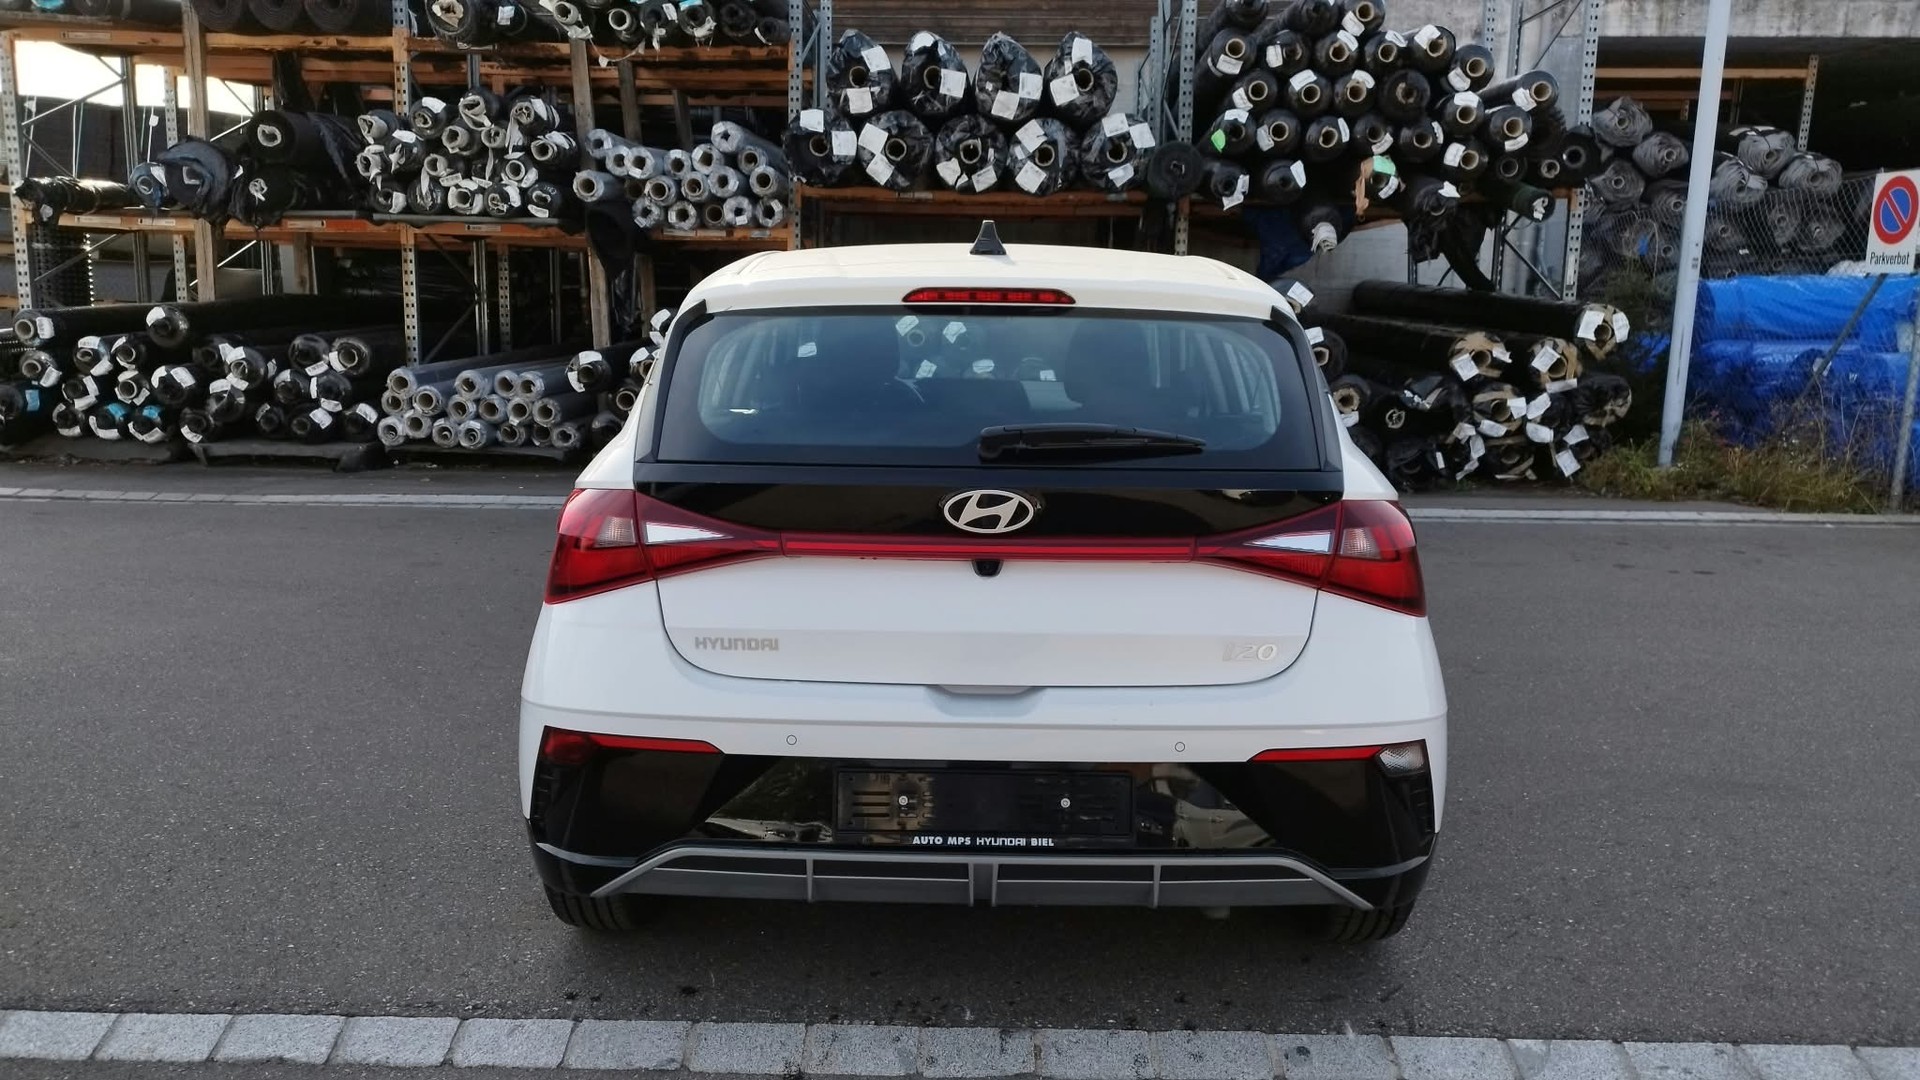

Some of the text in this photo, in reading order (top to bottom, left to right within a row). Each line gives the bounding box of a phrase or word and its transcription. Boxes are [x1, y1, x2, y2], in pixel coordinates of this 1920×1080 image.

[1869, 251, 1910, 265] Parkverbot
[694, 636, 779, 651] HYUNDAI
[912, 836, 1054, 847] AUTO MPS HYUNDAI BIEL
